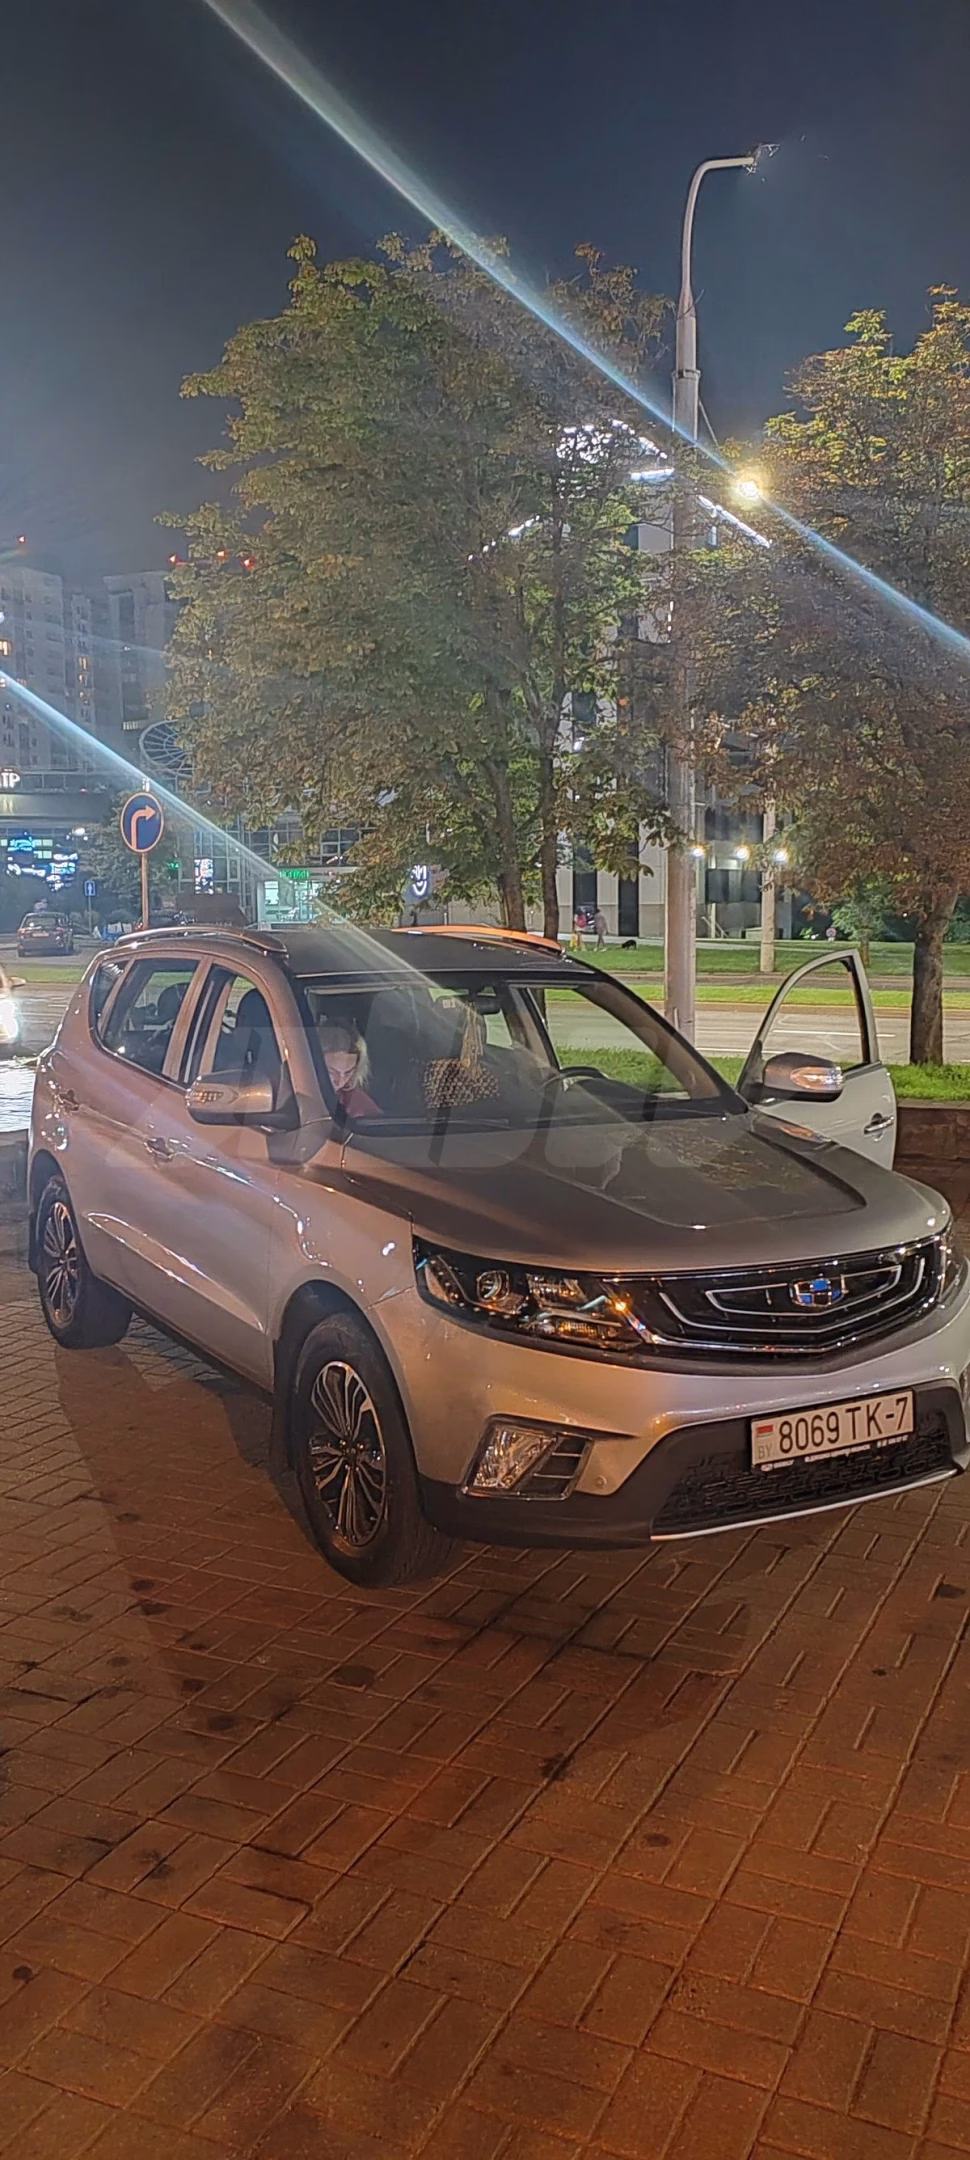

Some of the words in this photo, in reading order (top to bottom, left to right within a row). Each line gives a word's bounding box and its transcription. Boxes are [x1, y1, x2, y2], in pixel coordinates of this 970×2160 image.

[778, 1411, 840, 1454] 8069
[845, 1396, 909, 1440] TK-7
[758, 1443, 773, 1460] BY
